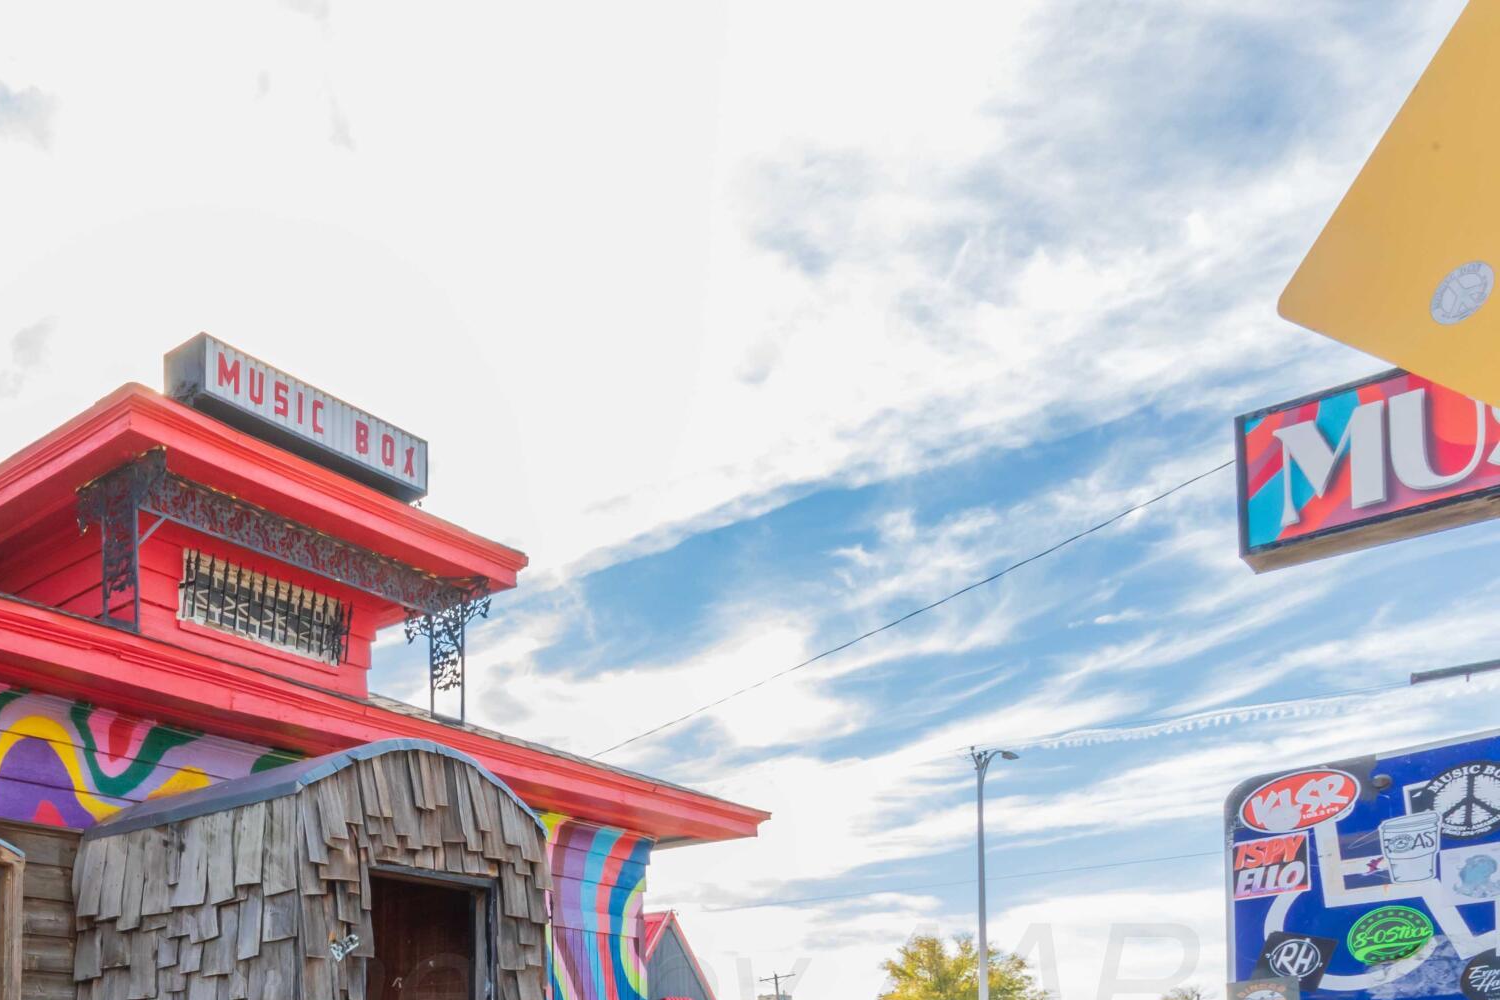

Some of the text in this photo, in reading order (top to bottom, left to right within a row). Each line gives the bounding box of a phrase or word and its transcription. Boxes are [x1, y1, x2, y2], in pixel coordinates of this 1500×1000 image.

[217, 351, 415, 478] MUSIC BOX
[1272, 387, 1500, 528] MU
[1427, 764, 1481, 793] MUSIC
[1275, 942, 1314, 977] RH
